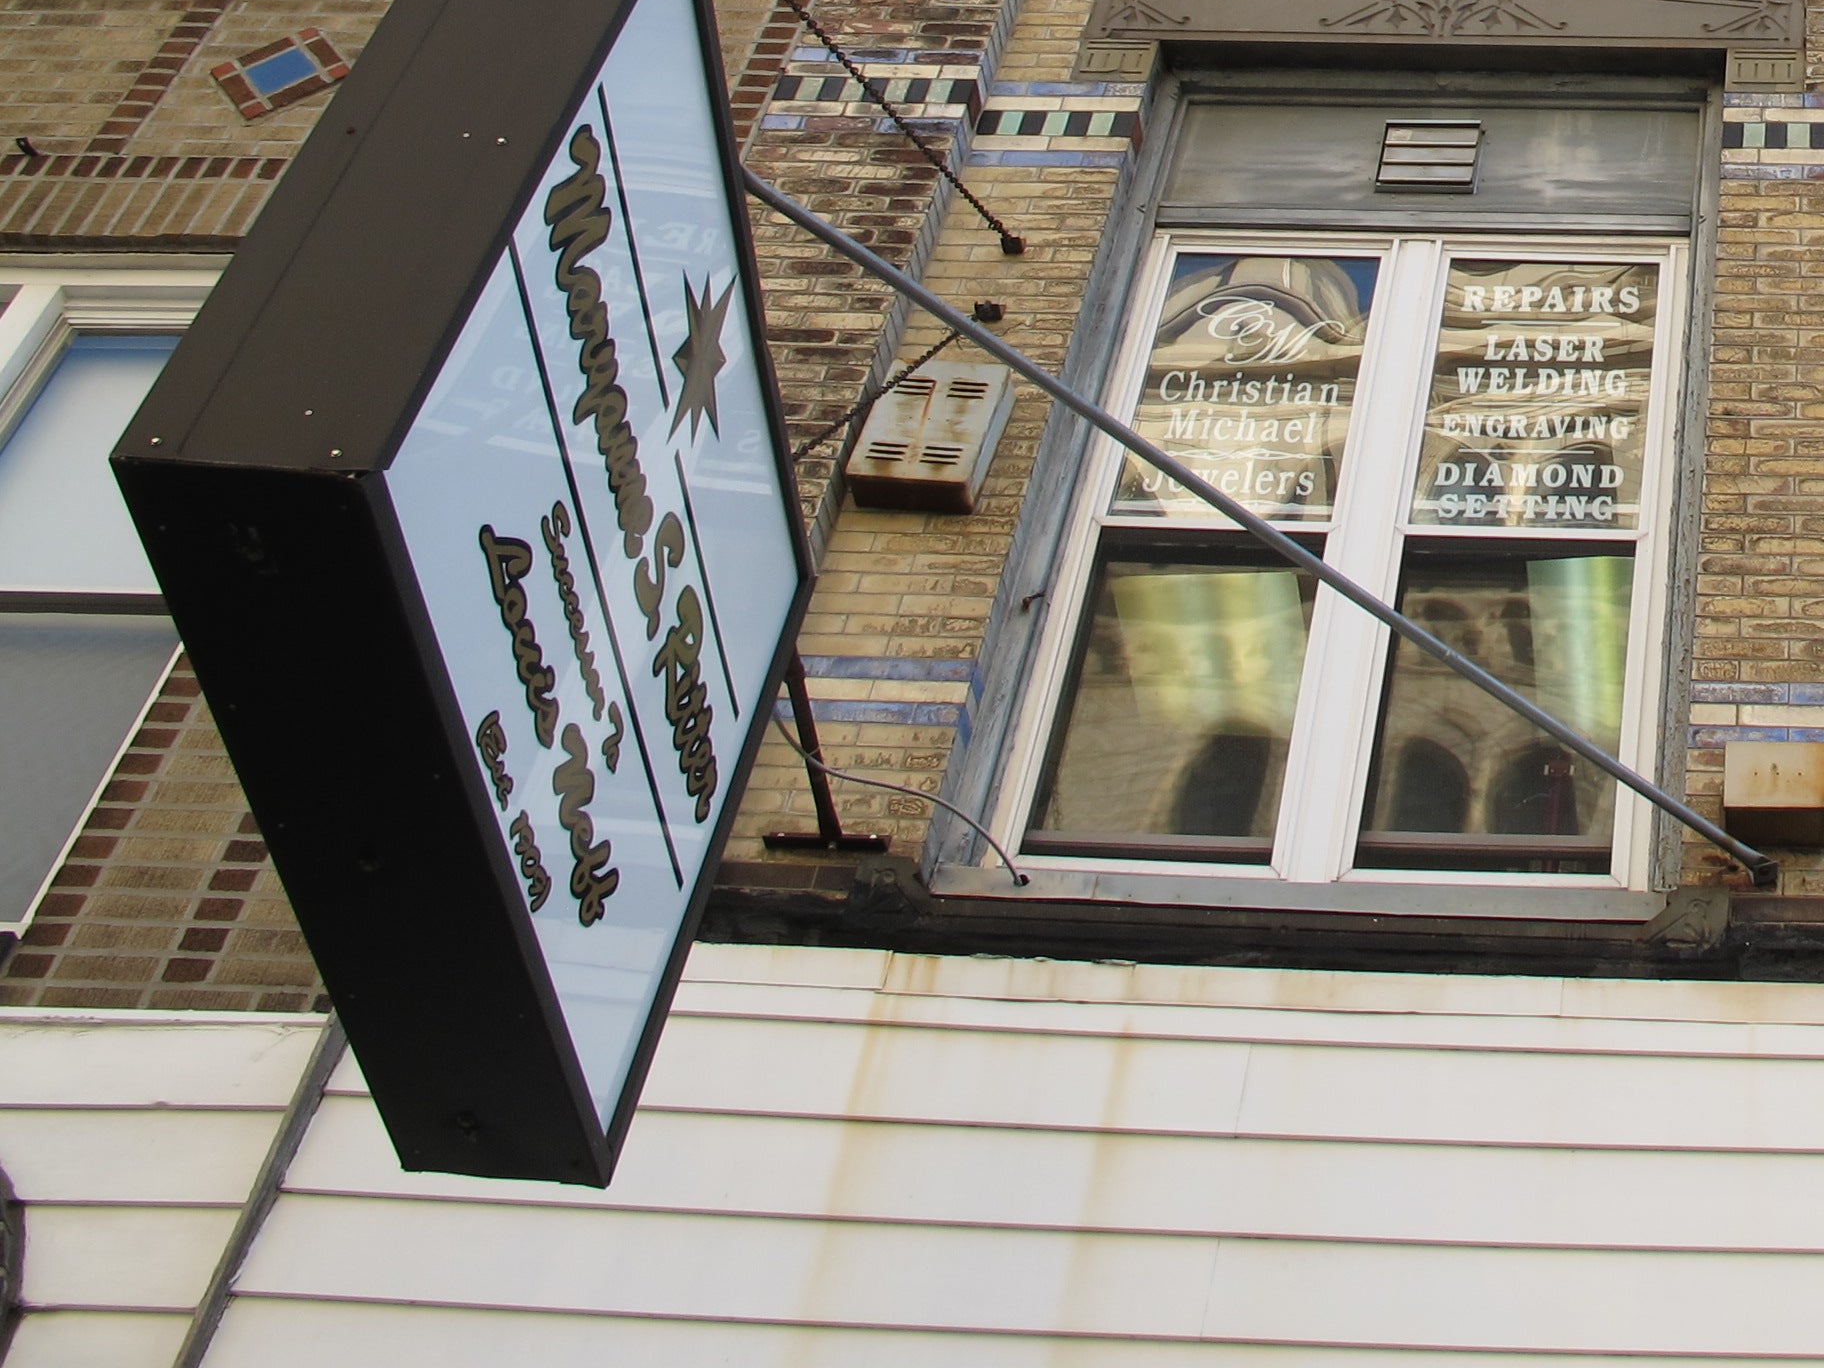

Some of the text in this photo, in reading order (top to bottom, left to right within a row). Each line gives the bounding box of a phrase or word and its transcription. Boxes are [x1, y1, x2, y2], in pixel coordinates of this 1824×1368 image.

[1461, 285, 1641, 314] REPAIRS
[1484, 335, 1605, 362] LASER
[1159, 370, 1339, 406] Christian
[1457, 367, 1628, 397] WELDING
[1163, 407, 1316, 443] Michael
[1441, 414, 1637, 440] ENGRAVING
[543, 123, 655, 559] Maryanne
[652, 584, 718, 824] Ritter
[1435, 462, 1625, 488] DIAMOND
[1437, 494, 1614, 521] SETTING
[540, 500, 624, 775] Successor To
[479, 523, 620, 929] Louis Neff
